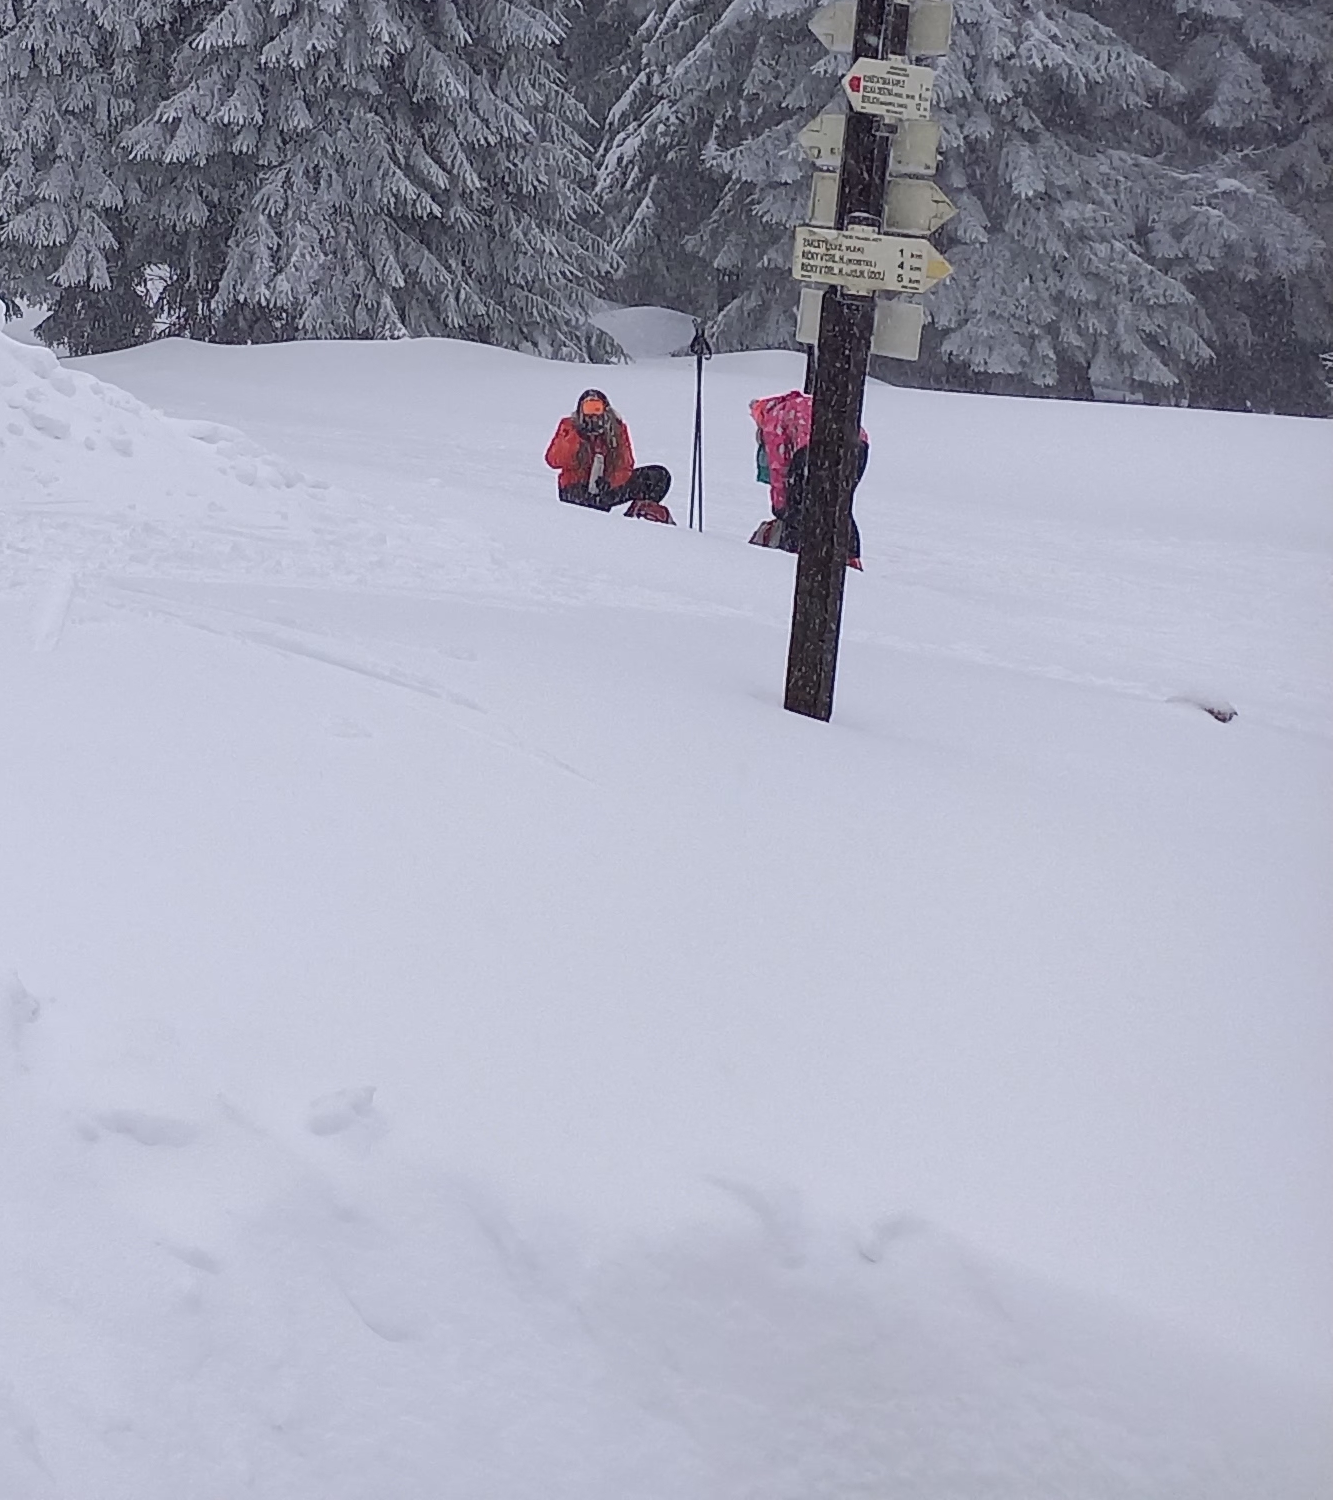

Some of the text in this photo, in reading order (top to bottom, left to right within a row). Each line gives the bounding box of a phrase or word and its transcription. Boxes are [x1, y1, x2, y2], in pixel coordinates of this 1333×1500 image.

[899, 248, 904, 258] 1
[897, 260, 922, 272] 4 km
[897, 274, 921, 285] 5 km
